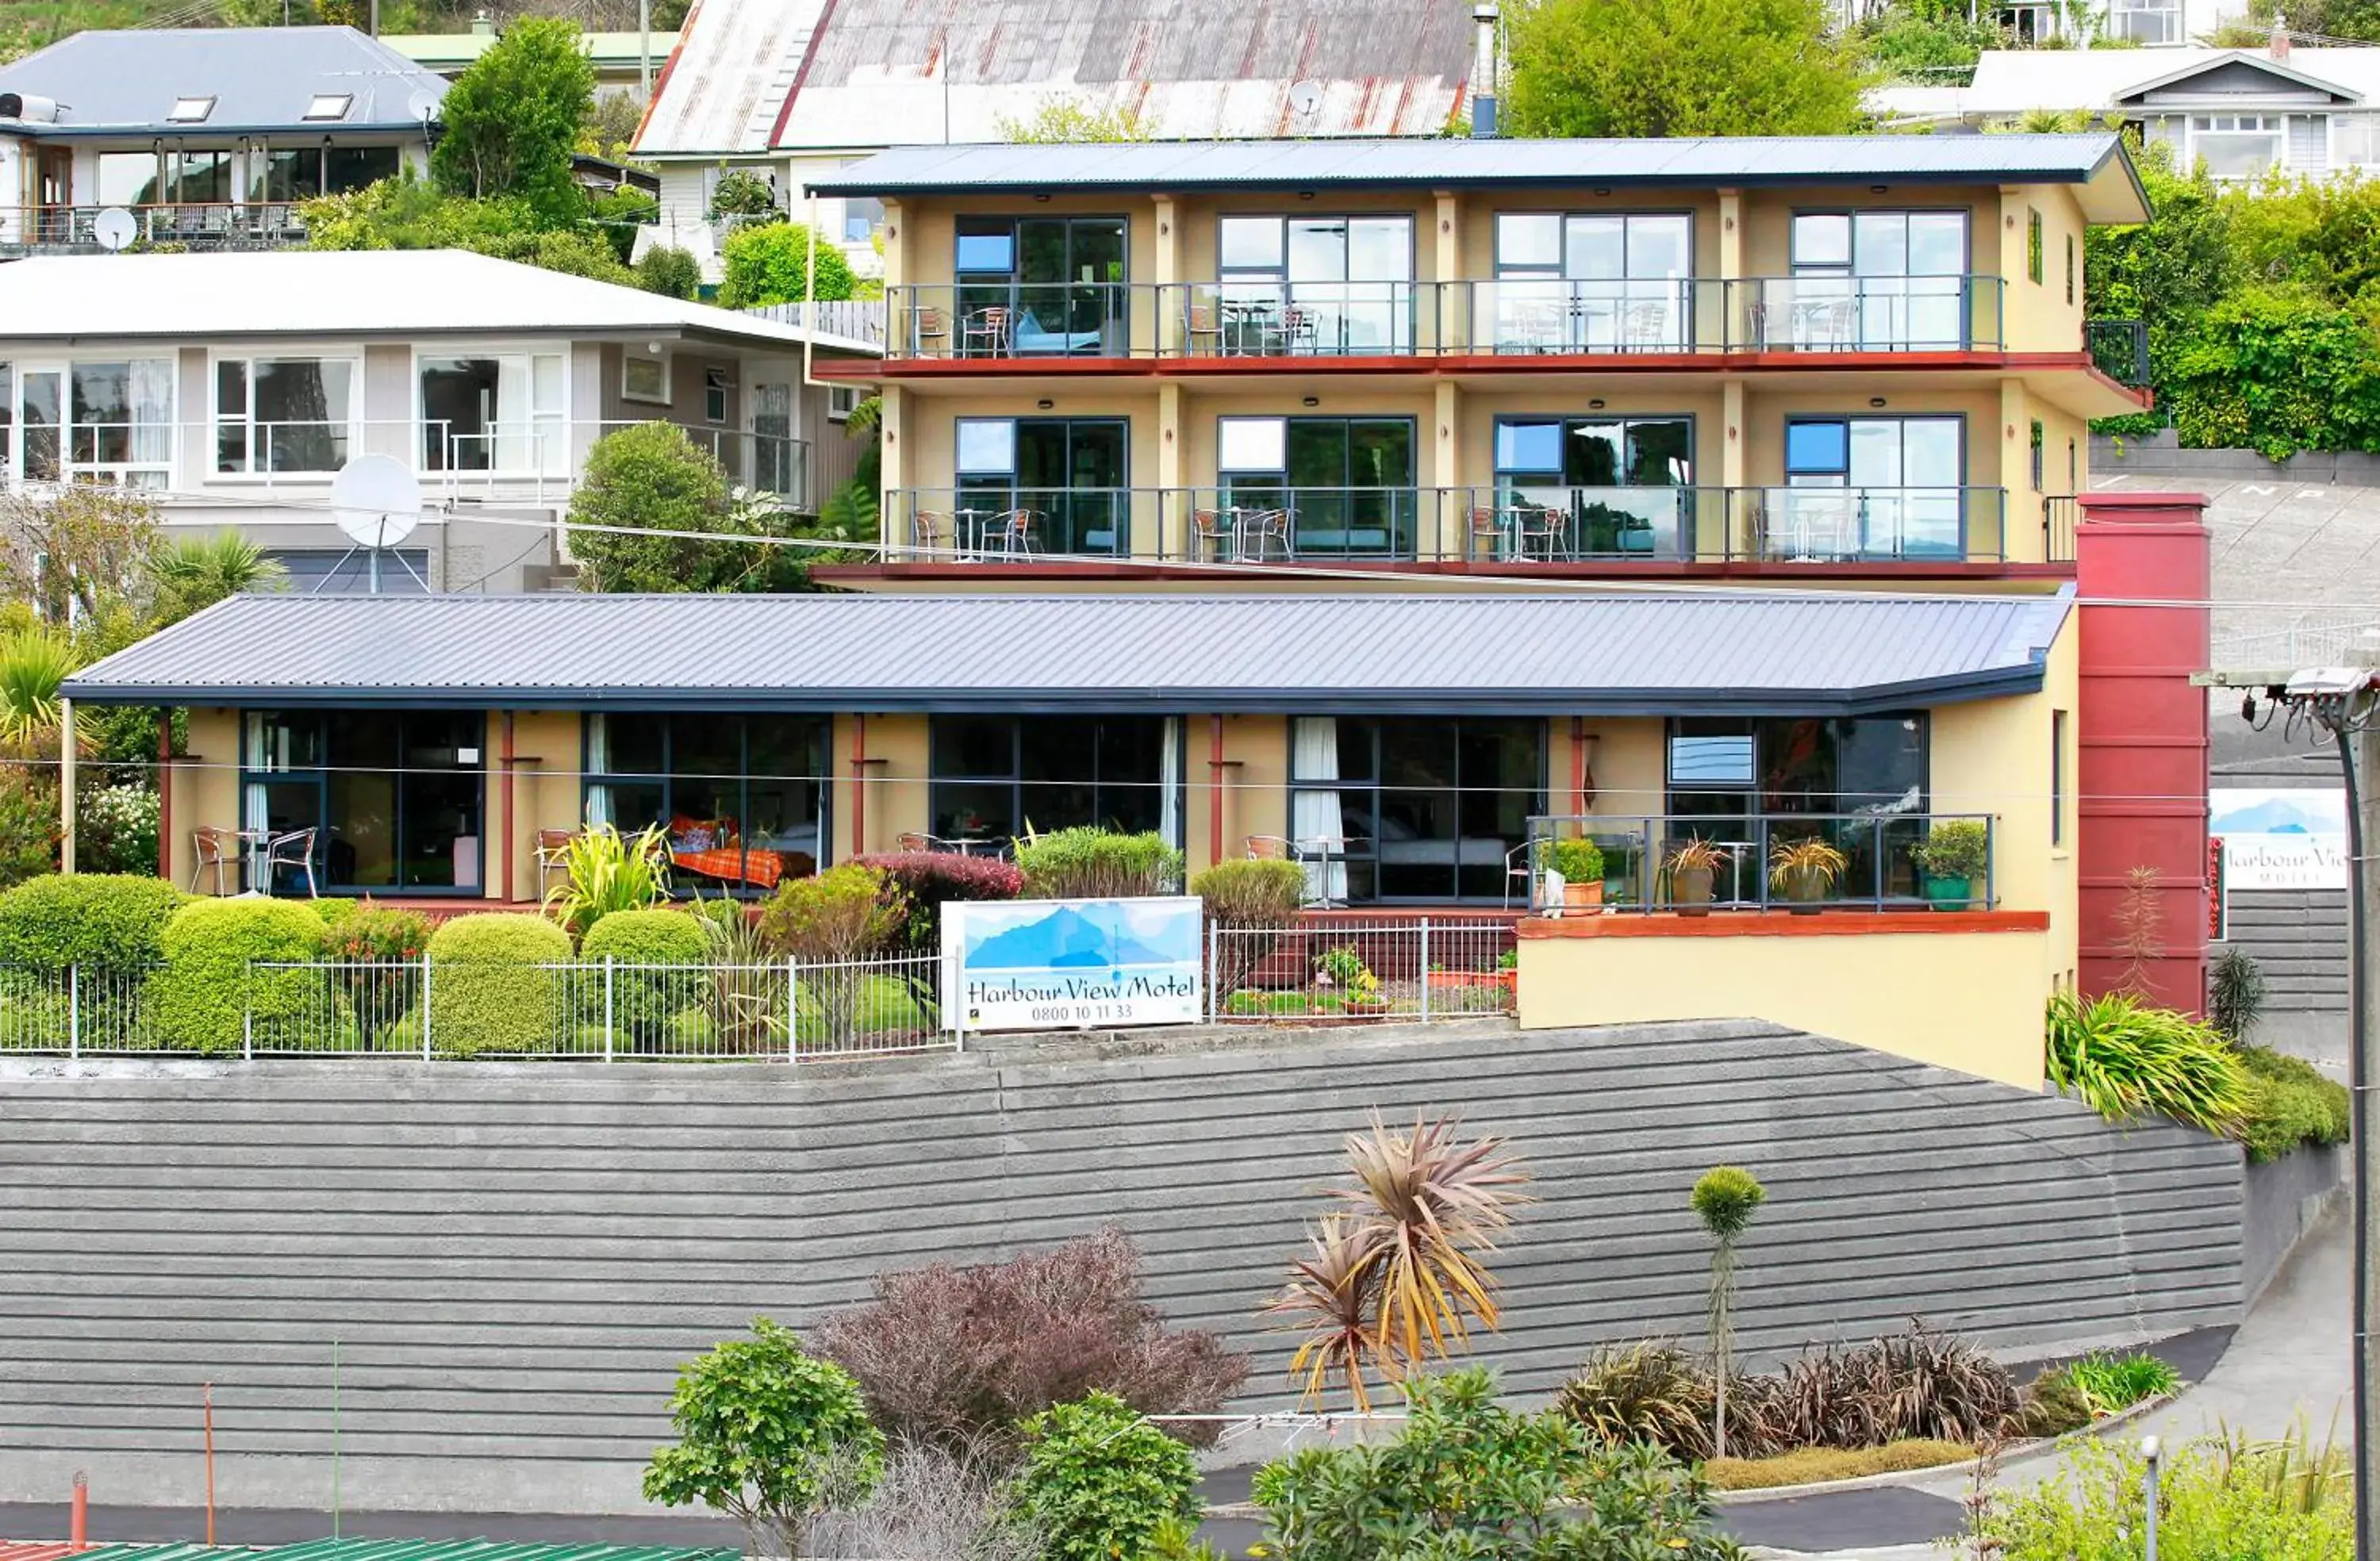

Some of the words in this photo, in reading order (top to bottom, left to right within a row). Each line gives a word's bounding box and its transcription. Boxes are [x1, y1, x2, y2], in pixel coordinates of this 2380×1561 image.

[2313, 848, 2346, 866] Vie
[968, 977, 1062, 1003] Harbour
[1065, 977, 1122, 999] View
[1127, 975, 1194, 998] Motel
[1032, 1007, 1069, 1021] 0800
[1076, 1006, 1091, 1019] 10
[1096, 1005, 1110, 1018] 11
[1117, 1004, 1132, 1018] 33
